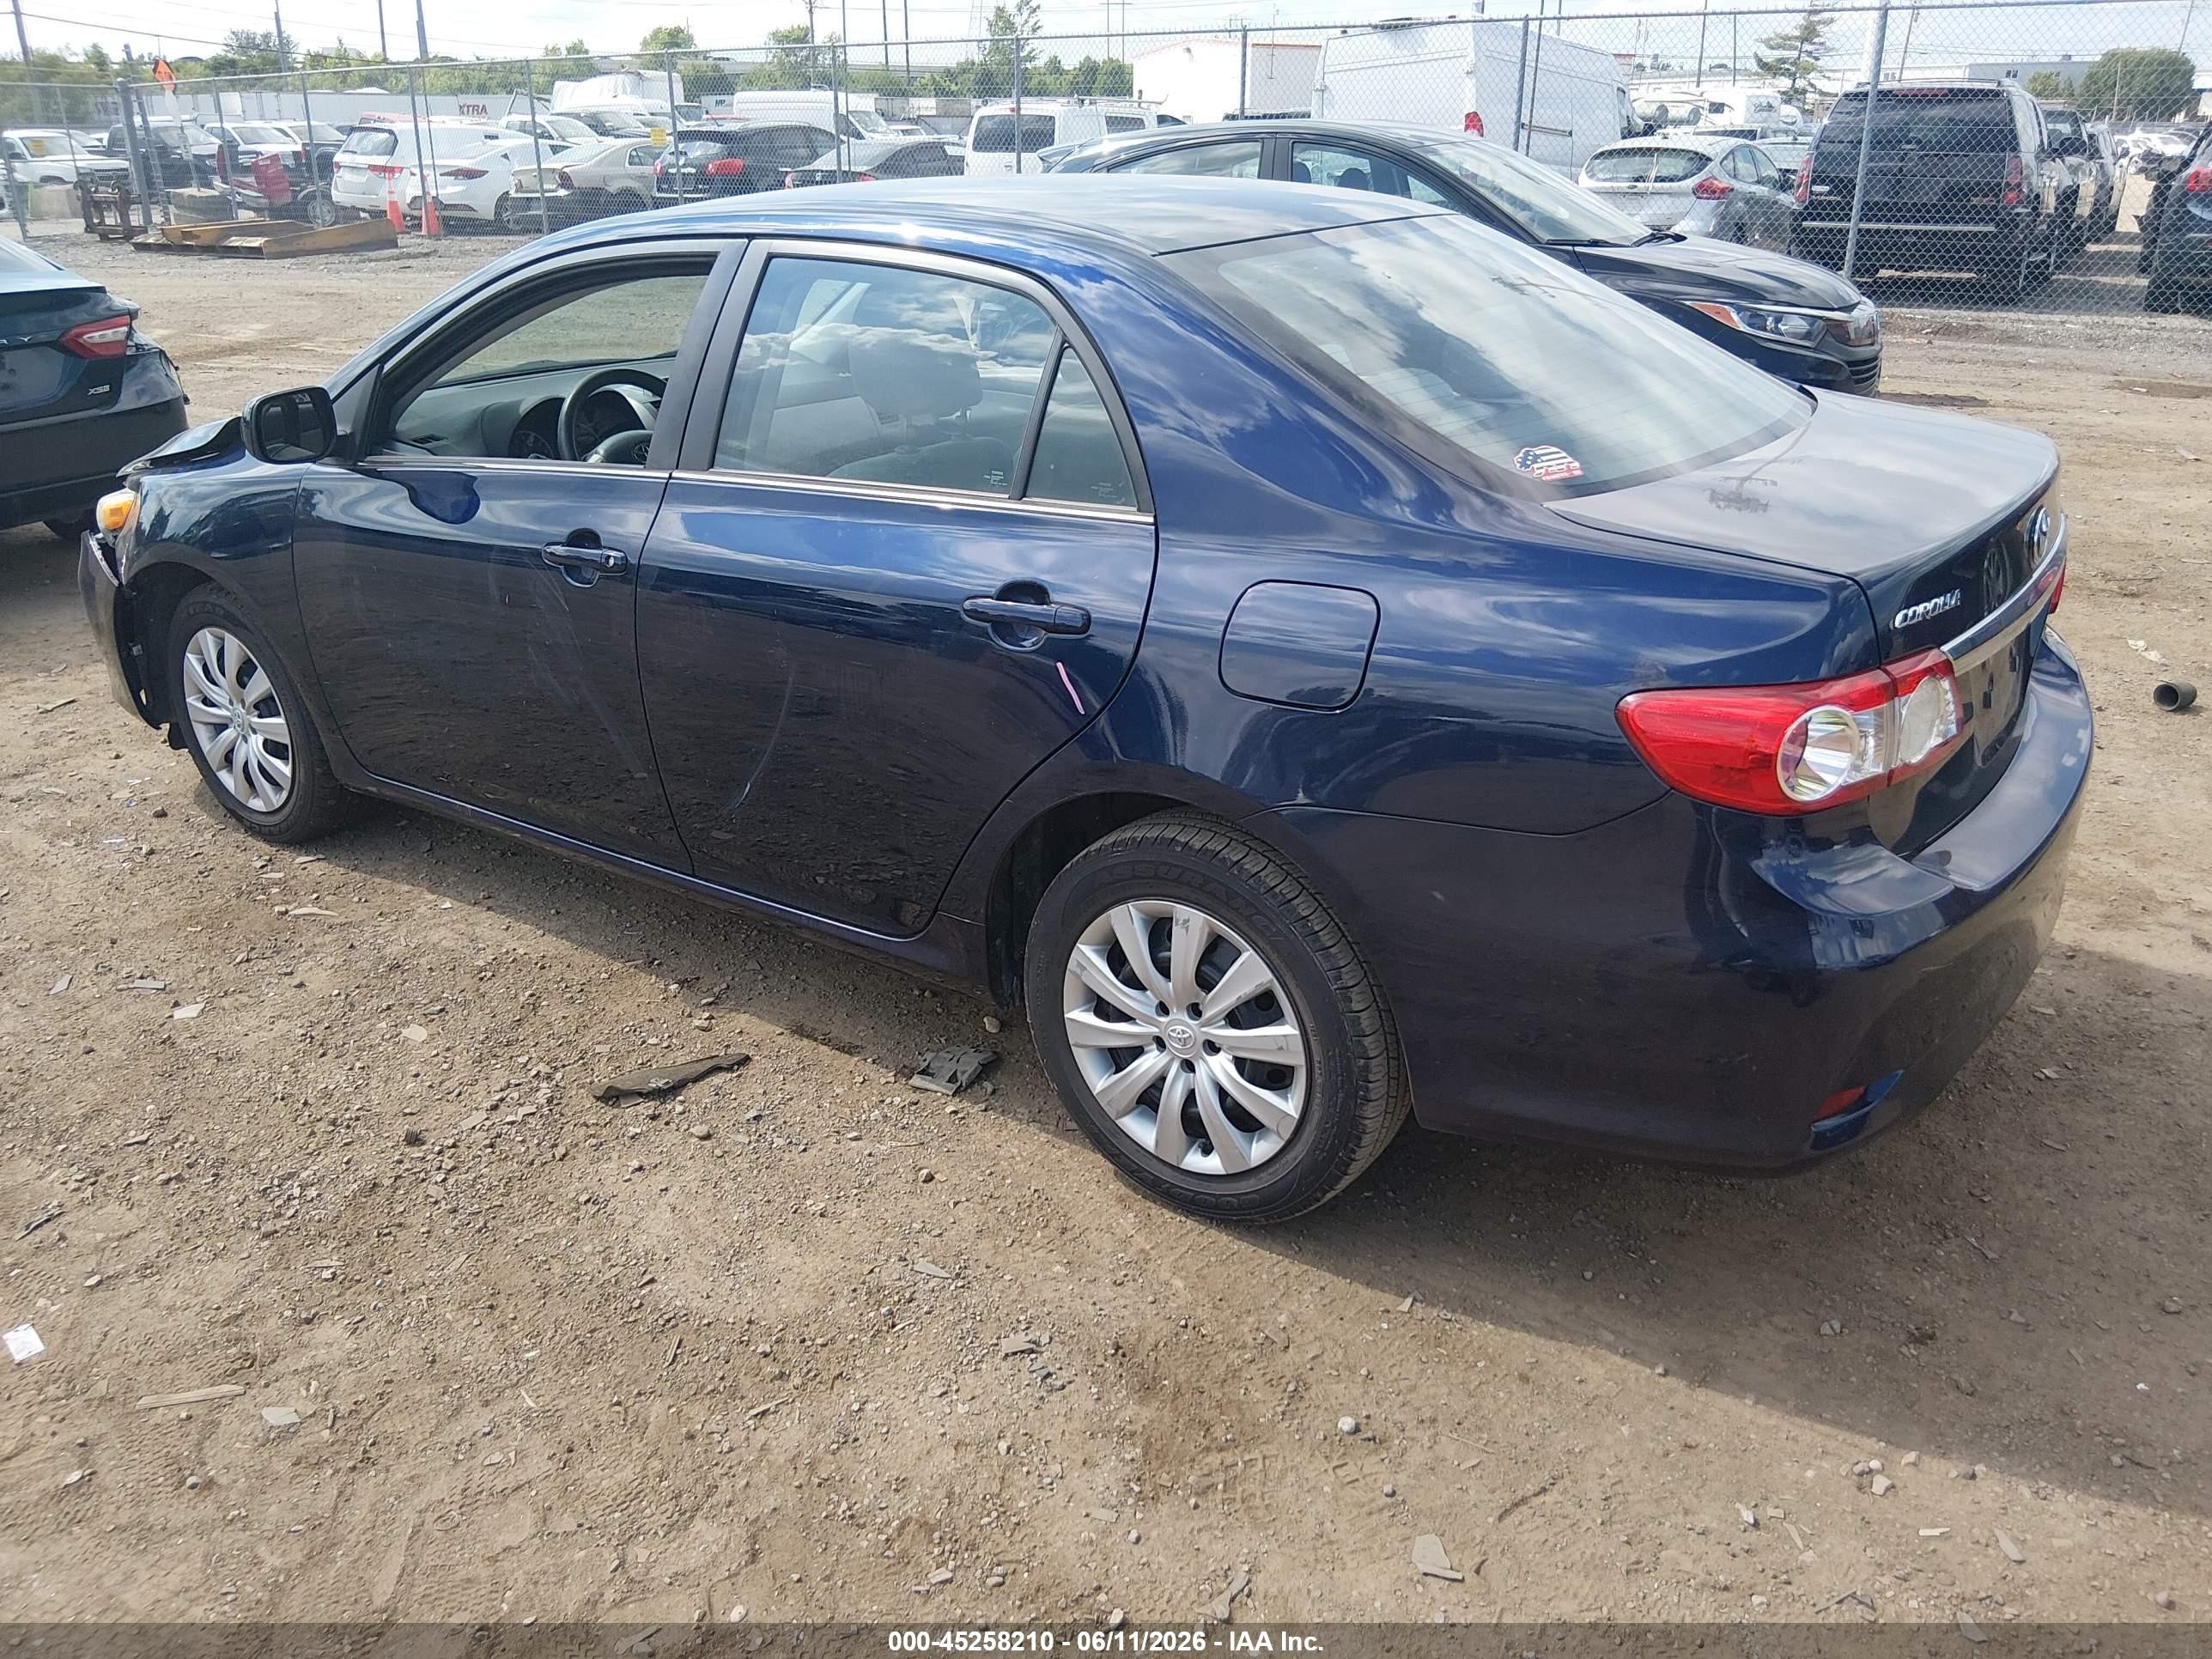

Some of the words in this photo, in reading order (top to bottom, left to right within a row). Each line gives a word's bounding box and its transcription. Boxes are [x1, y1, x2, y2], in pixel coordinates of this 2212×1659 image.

[459, 103, 489, 116] XTRA
[88, 385, 111, 396] XSE
[1894, 588, 1961, 629] COROLLA
